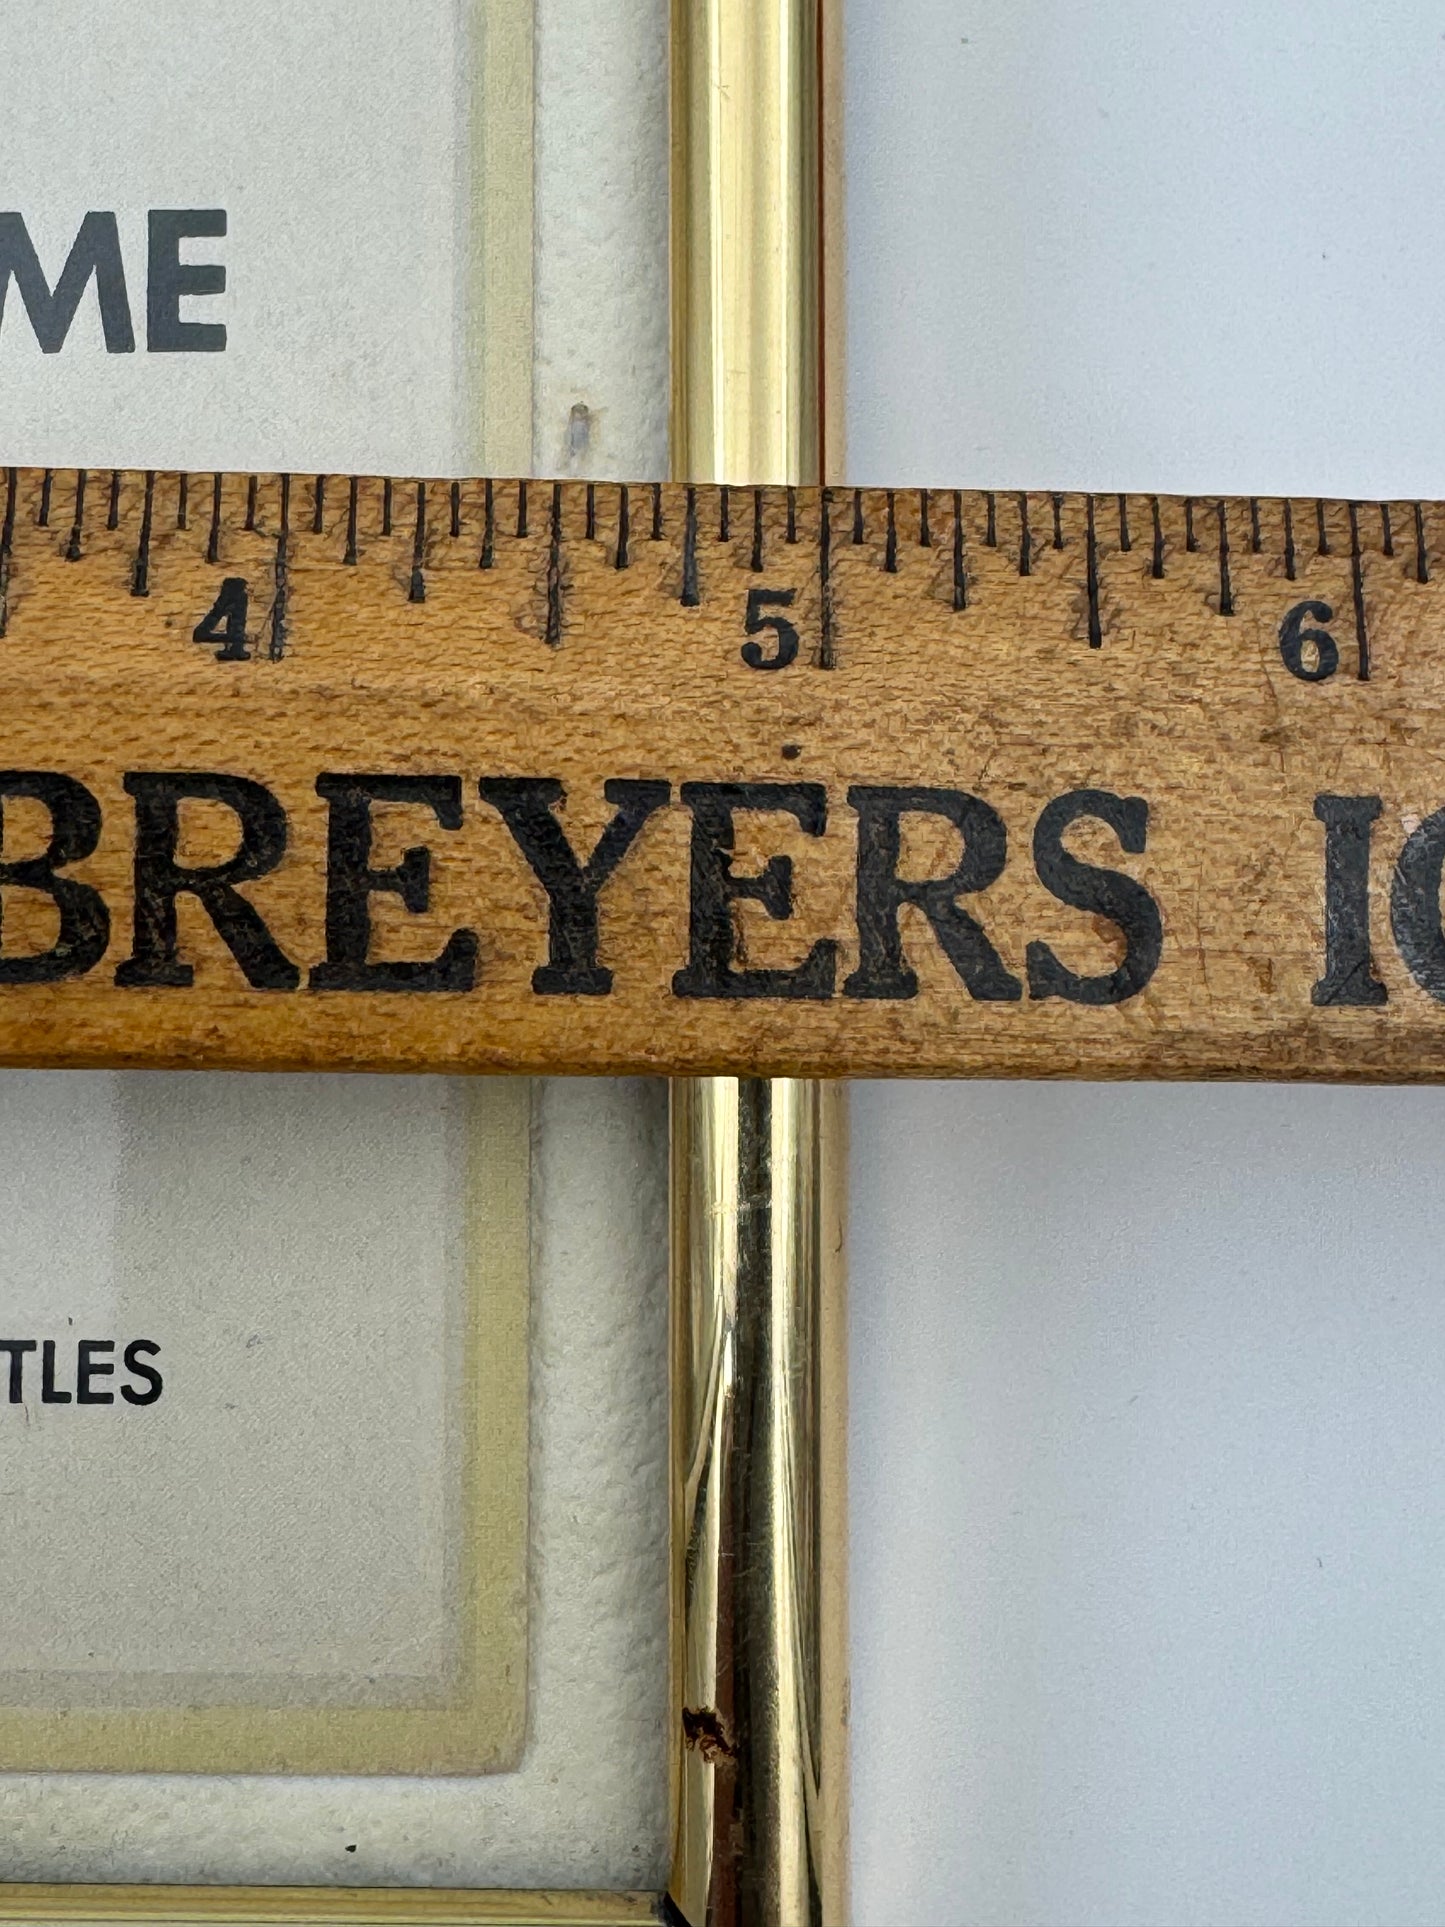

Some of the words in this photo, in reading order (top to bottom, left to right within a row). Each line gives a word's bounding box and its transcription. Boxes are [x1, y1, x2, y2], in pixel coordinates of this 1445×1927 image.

[0, 208, 228, 354] ME
[192, 576, 252, 662] 4
[740, 587, 800, 670] 5
[1279, 599, 1340, 682] 6
[0, 769, 1164, 1007] BREYERS
[0, 1338, 164, 1406] TLES
